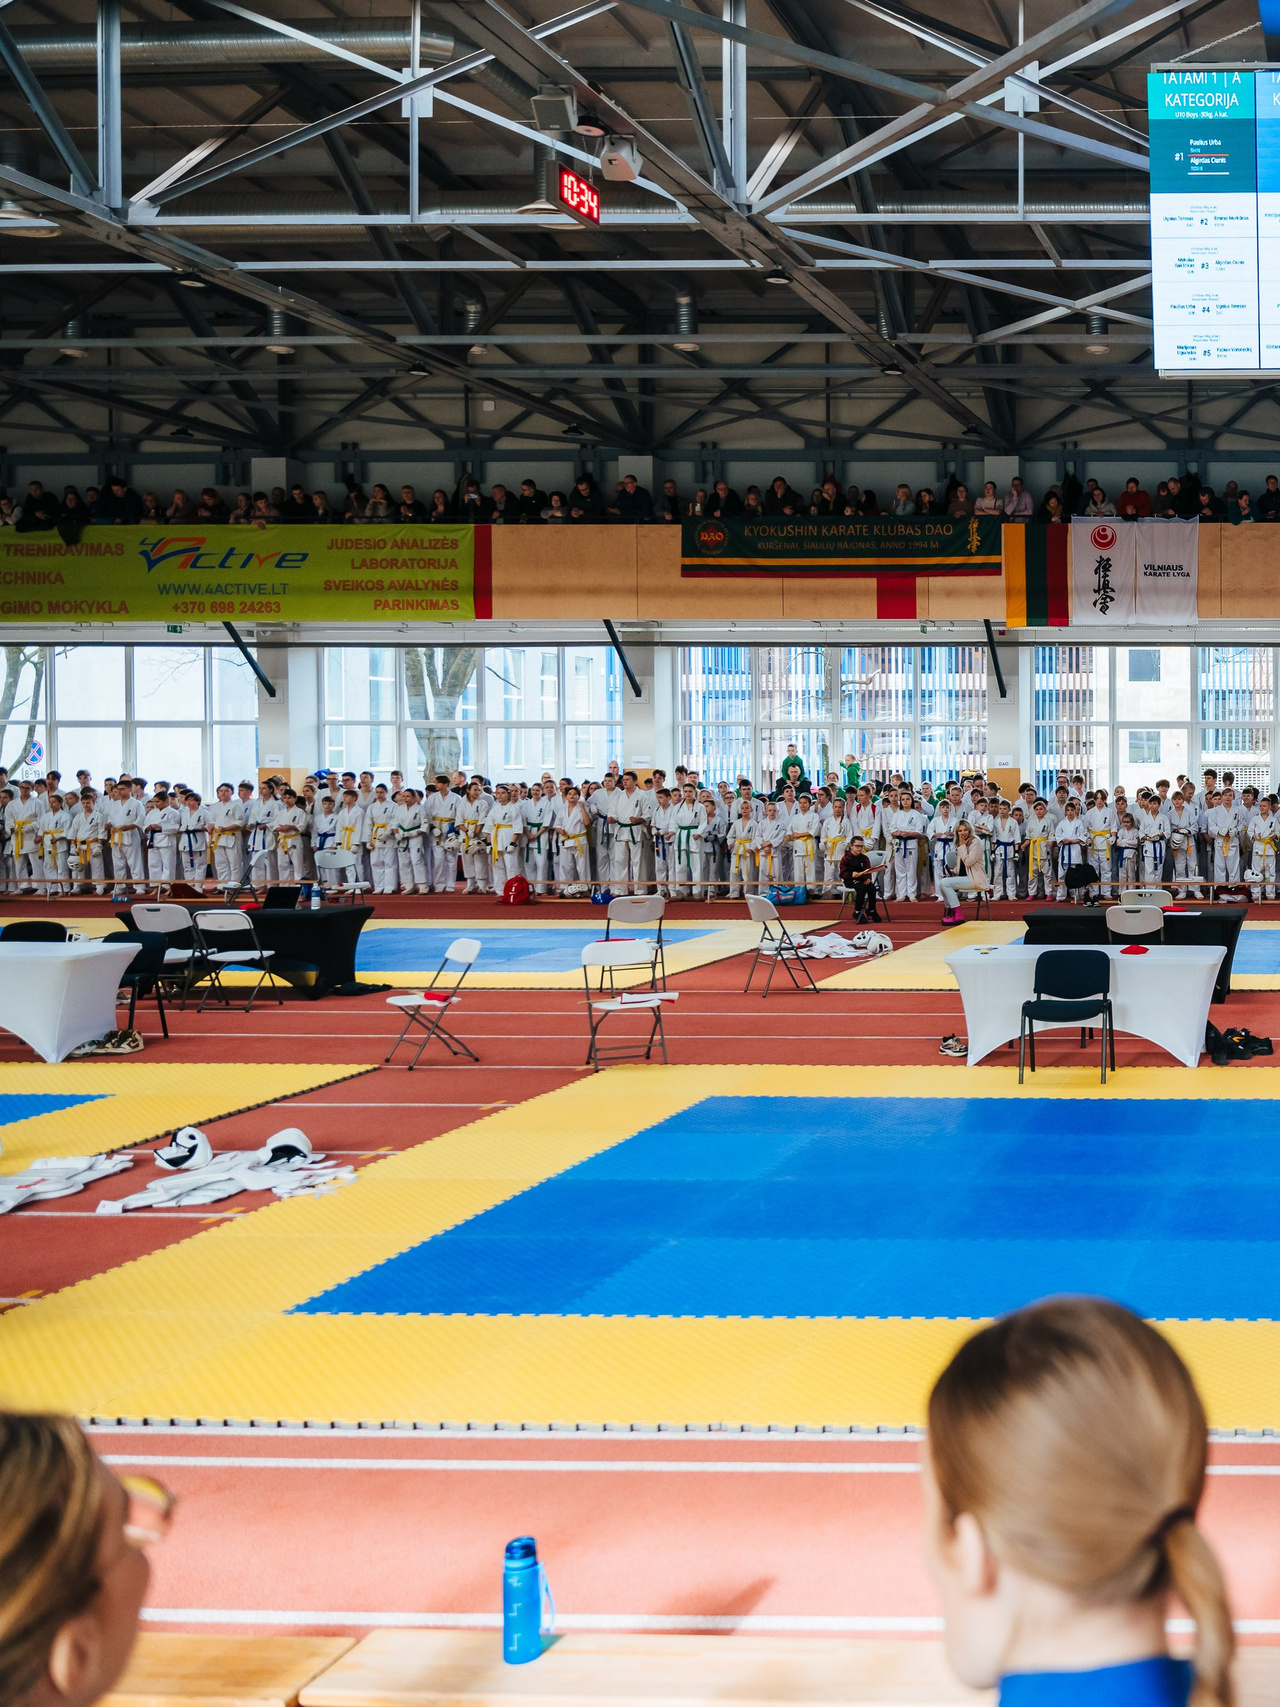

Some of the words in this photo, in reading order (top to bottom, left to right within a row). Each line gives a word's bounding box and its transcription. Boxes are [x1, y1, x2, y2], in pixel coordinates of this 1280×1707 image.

[1232, 72, 1241, 84] A
[1165, 93, 1239, 109] KATEGORIJA
[1175, 153, 1184, 161] #1
[563, 174, 598, 219] 10:34
[744, 525, 817, 536] KYOKUSHIN
[822, 524, 869, 536] KARATE
[874, 524, 921, 536] KLUBAS
[926, 524, 953, 536] DAO
[4, 542, 125, 556] TRENIRAVIMAS
[326, 538, 387, 550] JUDESIO
[390, 536, 459, 550] ANALIZĖS
[880, 541, 905, 549] ANNO
[908, 541, 928, 549] 1994
[351, 558, 459, 570] LABORATORIJA
[0, 571, 65, 585] CHNIKA
[324, 580, 384, 591] SVEIKOS
[388, 577, 459, 591] AVALYNĖS
[158, 583, 290, 595] WWW.4ACTIVE.LT
[48, 600, 130, 614] MOKYKLA
[172, 601, 206, 614] +370
[210, 601, 235, 614] 698
[239, 601, 281, 614] 24263
[374, 599, 460, 610] PARINKIMAS
